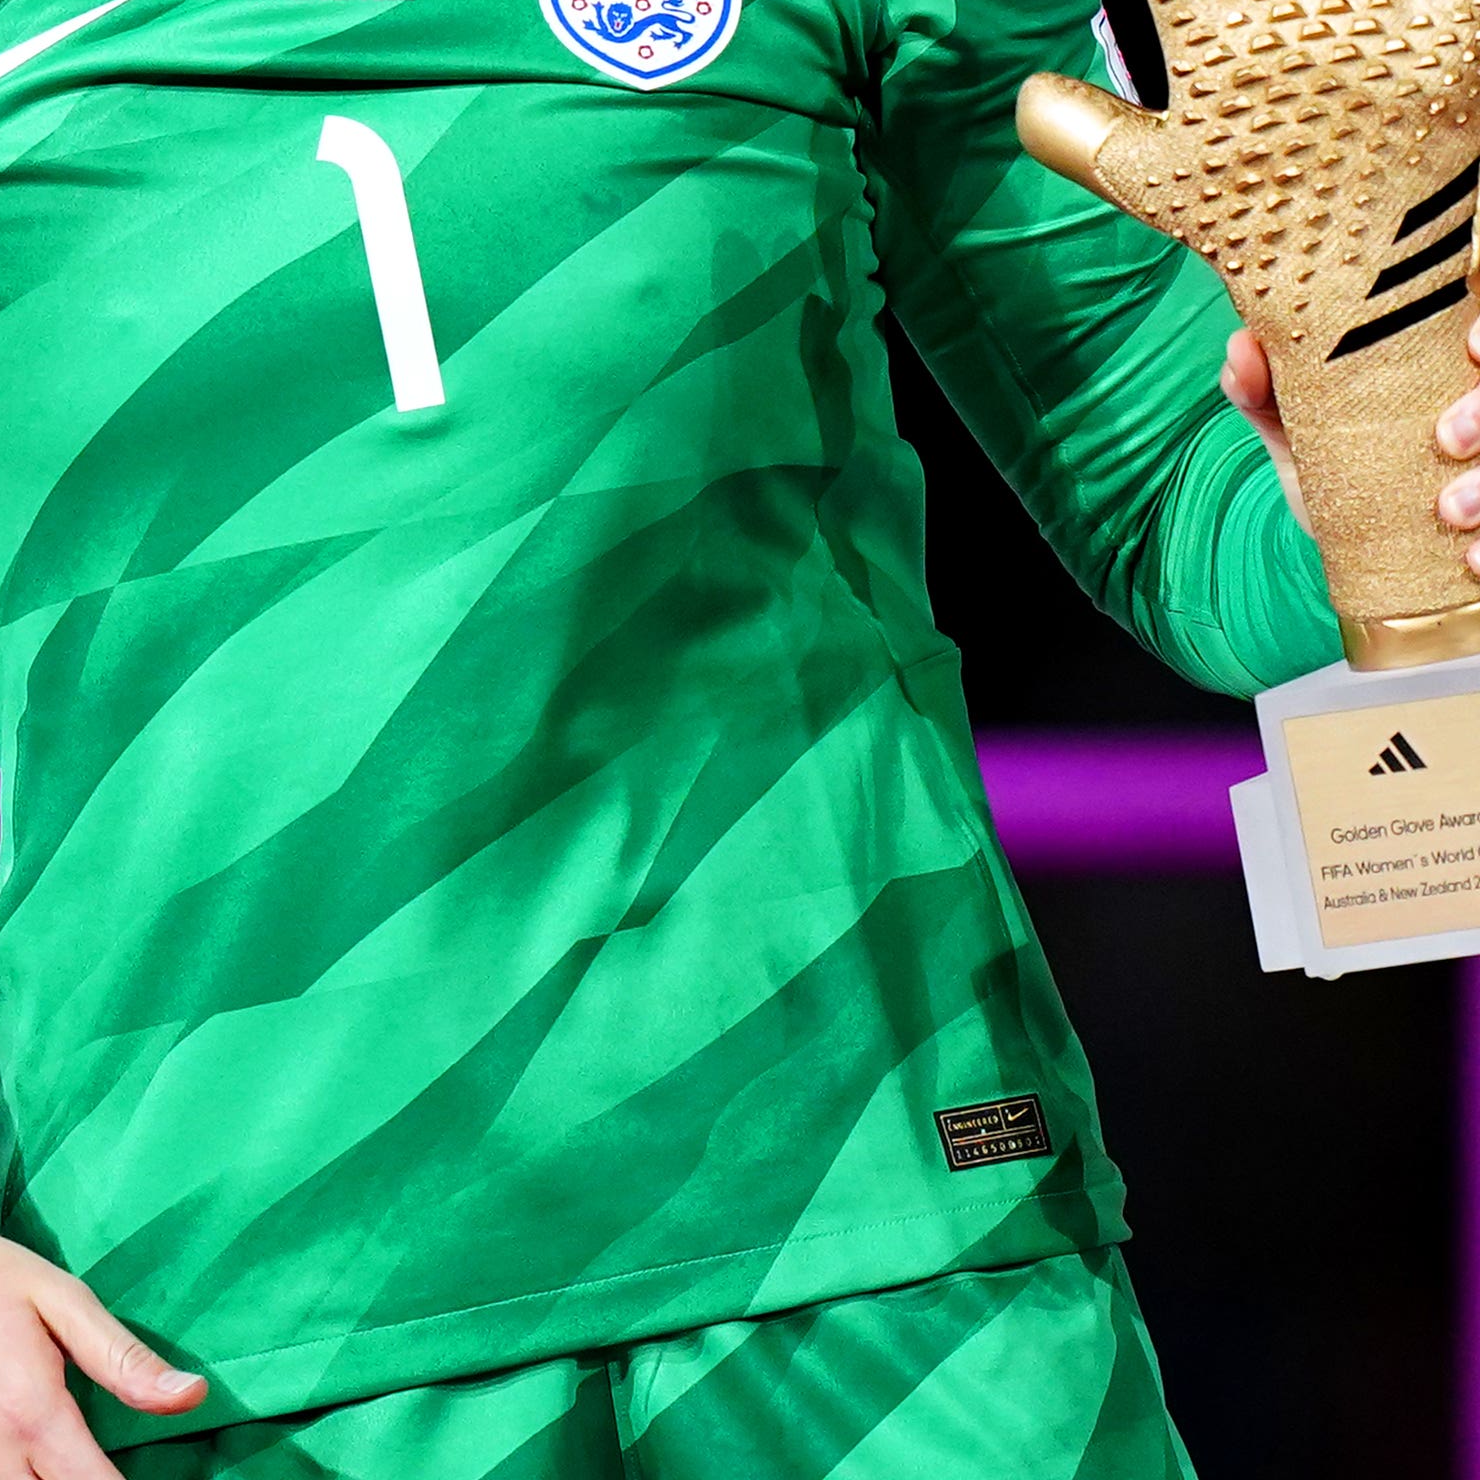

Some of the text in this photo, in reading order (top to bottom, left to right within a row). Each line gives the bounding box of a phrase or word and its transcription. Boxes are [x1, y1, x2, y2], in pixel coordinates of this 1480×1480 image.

[315, 114, 446, 413] 1
[1330, 824, 1388, 844] Golden
[1390, 818, 1435, 836] Glove
[1321, 865, 1353, 881] FIFA
[1432, 845, 1475, 865] World
[1323, 892, 1376, 910] Australia
[1379, 889, 1388, 901] &
[1391, 886, 1419, 900] New
[1421, 878, 1472, 896] Zealand
